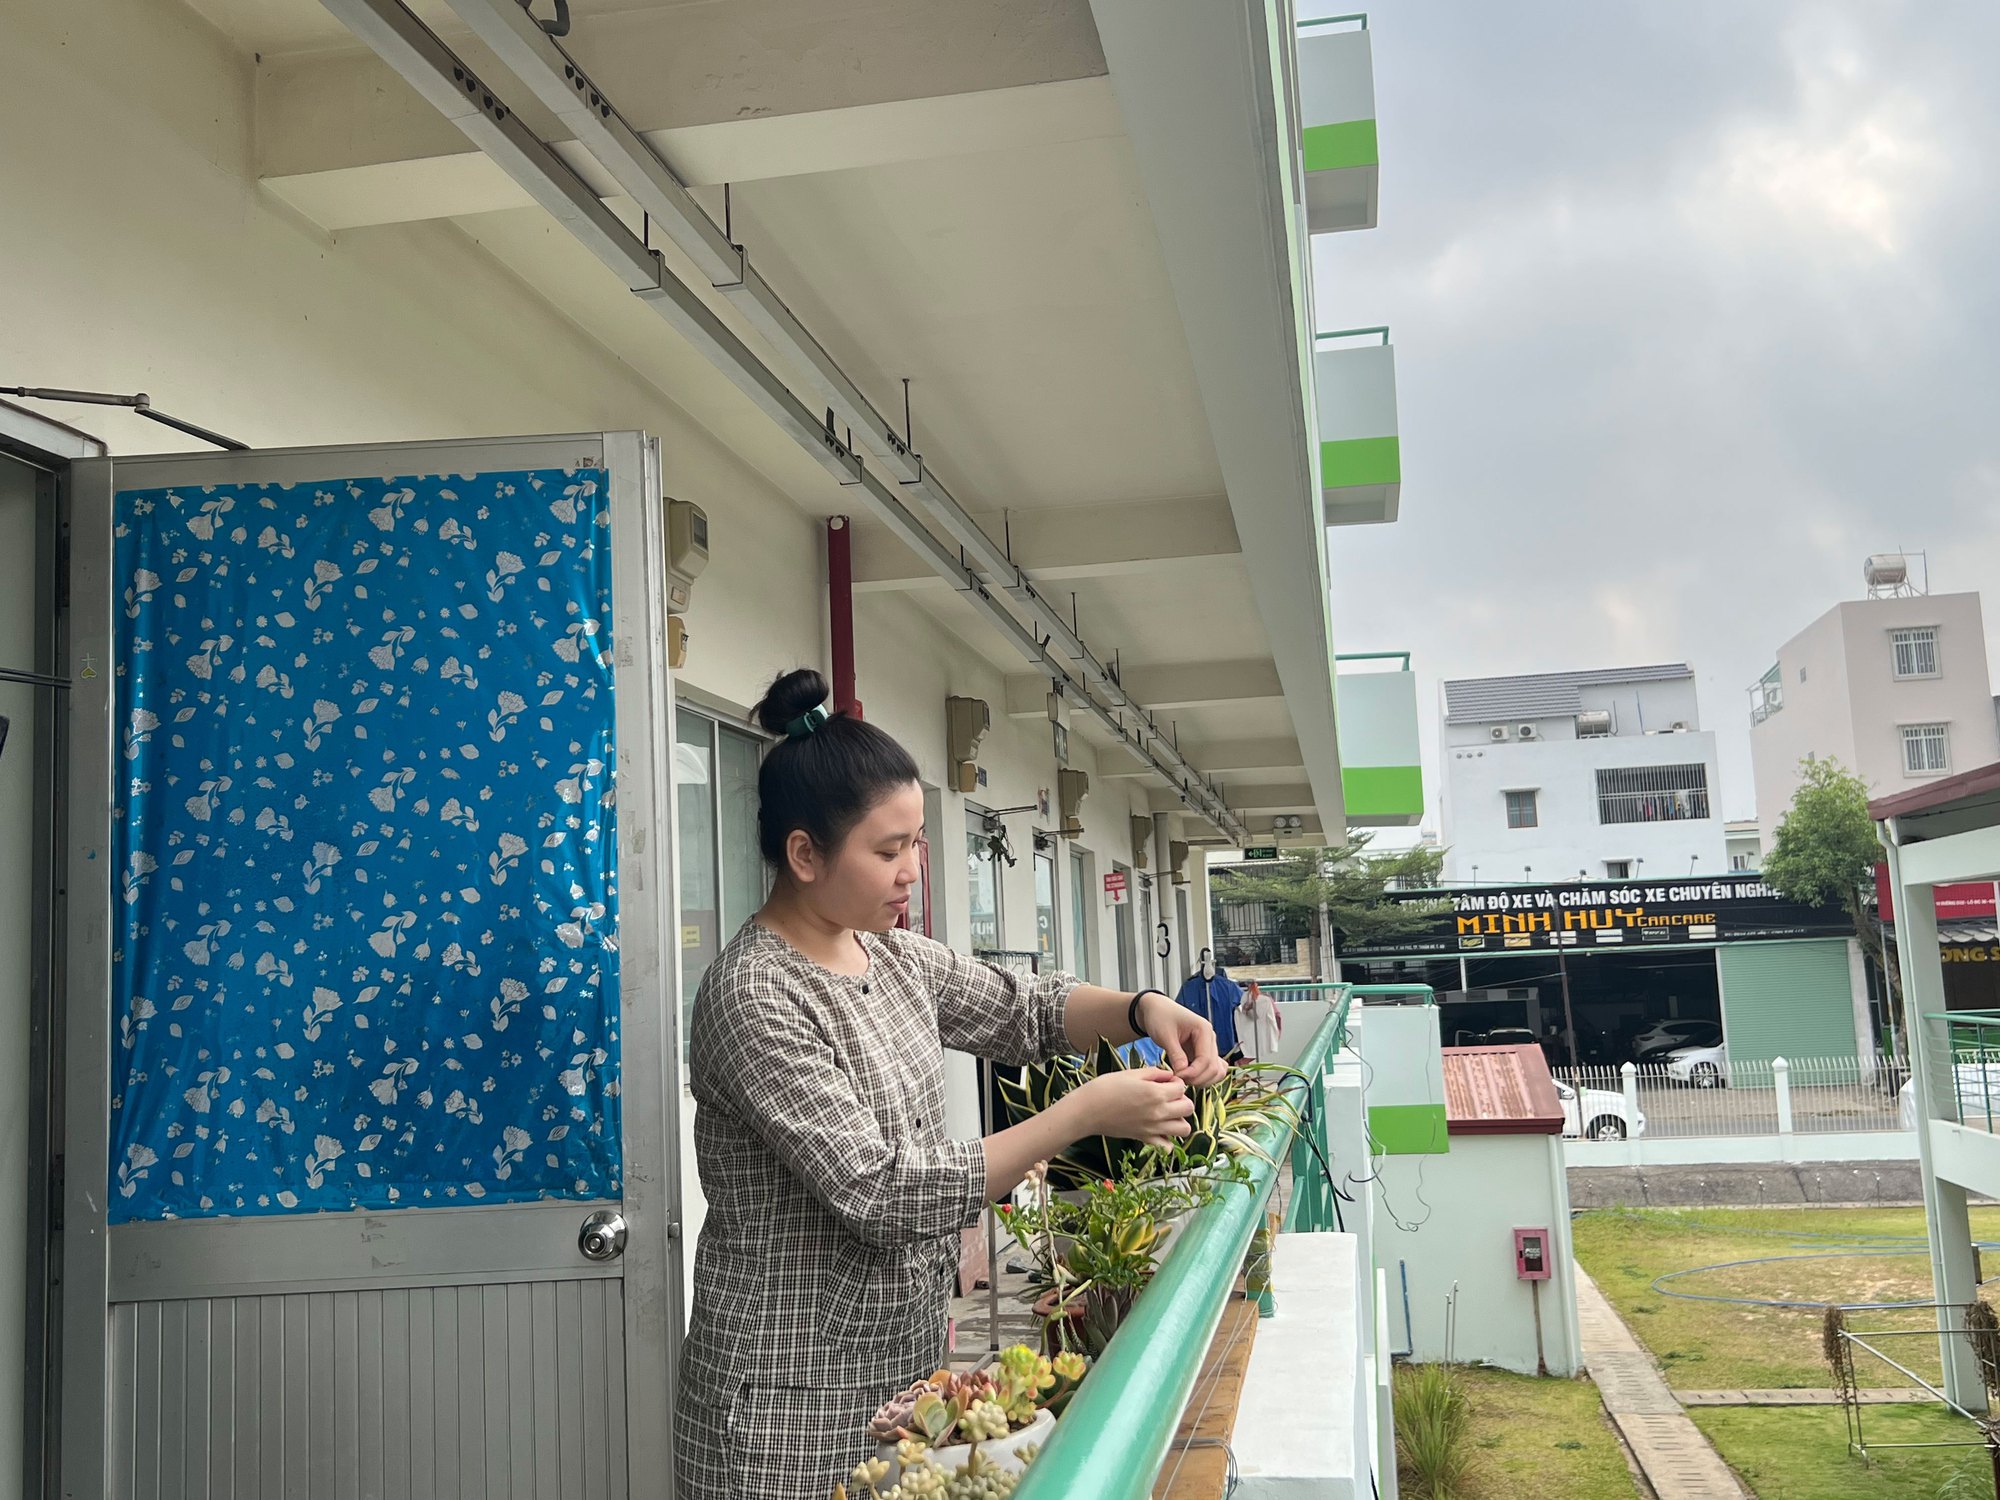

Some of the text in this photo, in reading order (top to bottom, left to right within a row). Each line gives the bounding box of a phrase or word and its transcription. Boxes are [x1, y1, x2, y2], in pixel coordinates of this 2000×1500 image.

[1451, 893, 1485, 912] TÂM
[1487, 891, 1509, 913] ĐỘ
[1512, 894, 1533, 909] XE
[1535, 889, 1555, 910] VÀ
[1559, 887, 1606, 907] CHĂM
[1609, 885, 1641, 905] SÓC
[1645, 887, 1666, 903] XE
[1669, 881, 1732, 902] CHUYÊN
[1457, 912, 1551, 935] MINH
[1564, 907, 1644, 930] HUY
